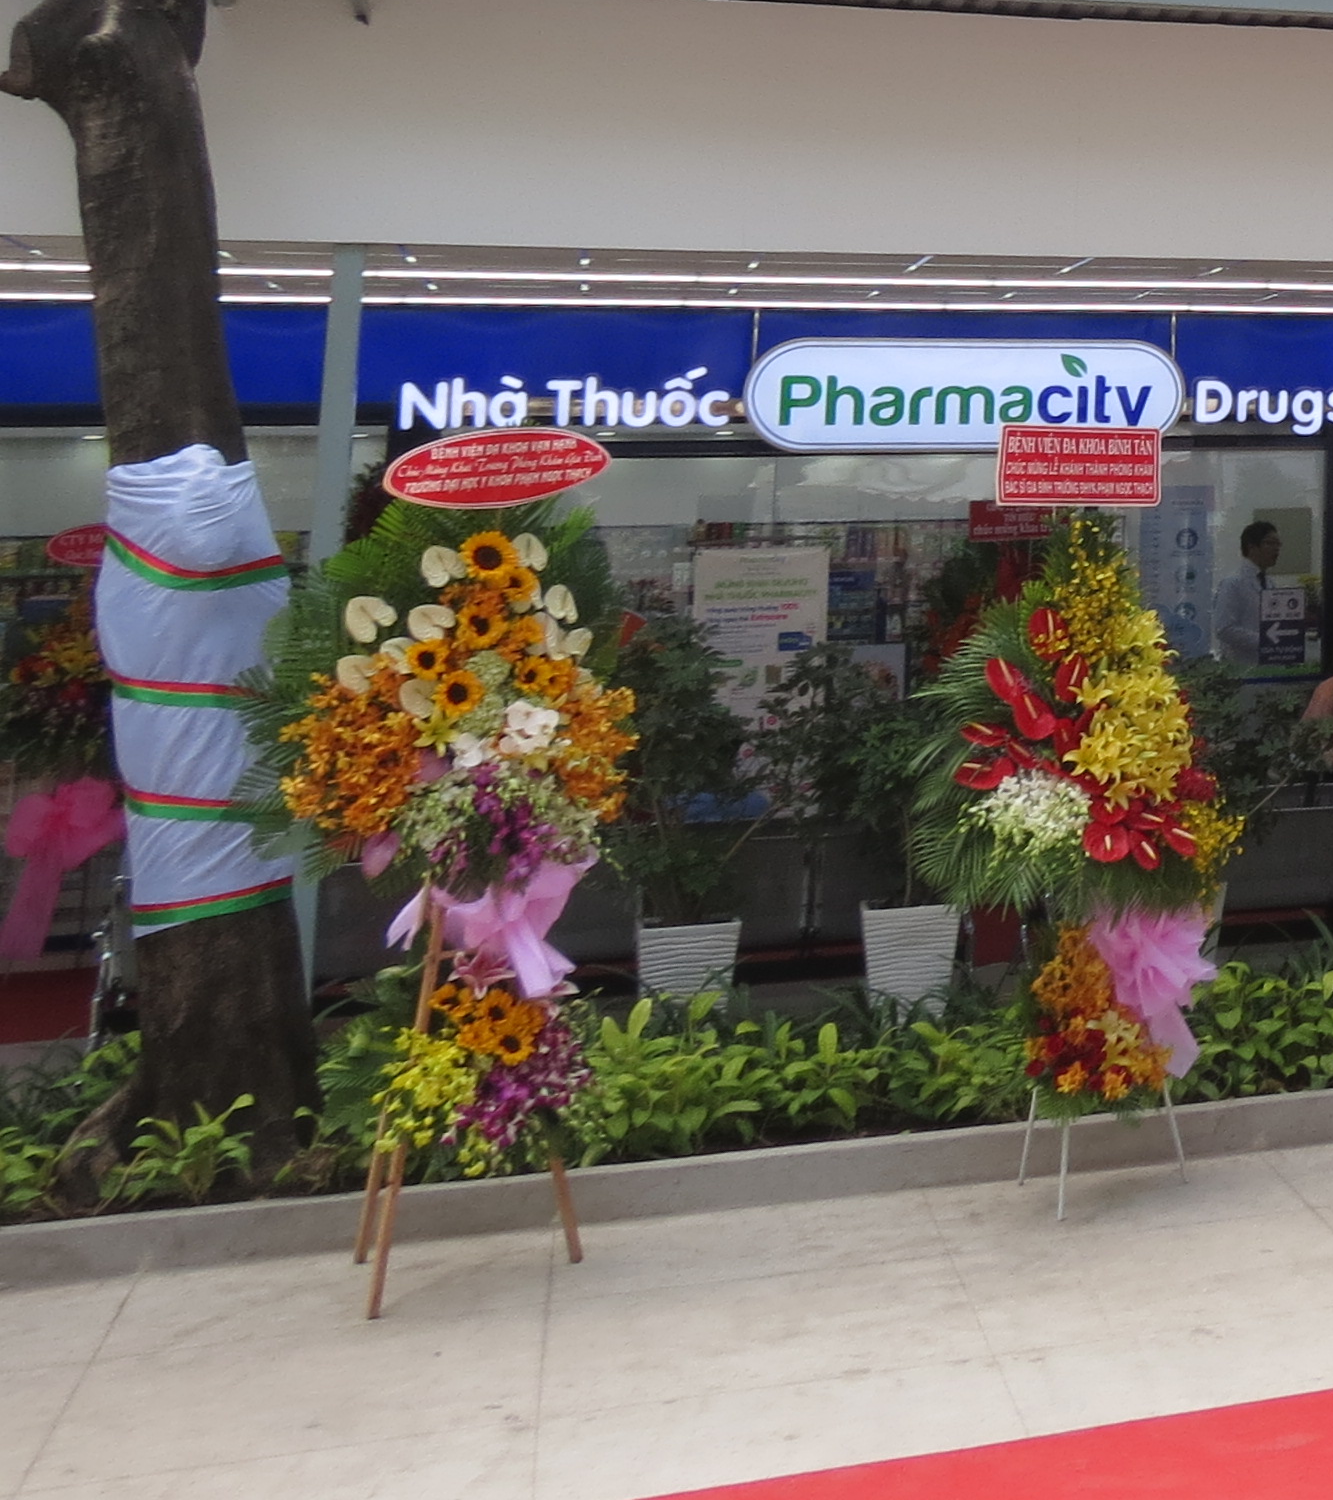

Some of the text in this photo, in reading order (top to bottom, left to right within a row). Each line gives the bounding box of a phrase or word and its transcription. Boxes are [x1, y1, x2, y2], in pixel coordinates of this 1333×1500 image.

[399, 366, 731, 430] Nhà Thuốc
[778, 358, 1152, 428] Pharmacity
[1008, 432, 1154, 458] BỆNH VIỆN ĐA KHOA BÌNH TÂN
